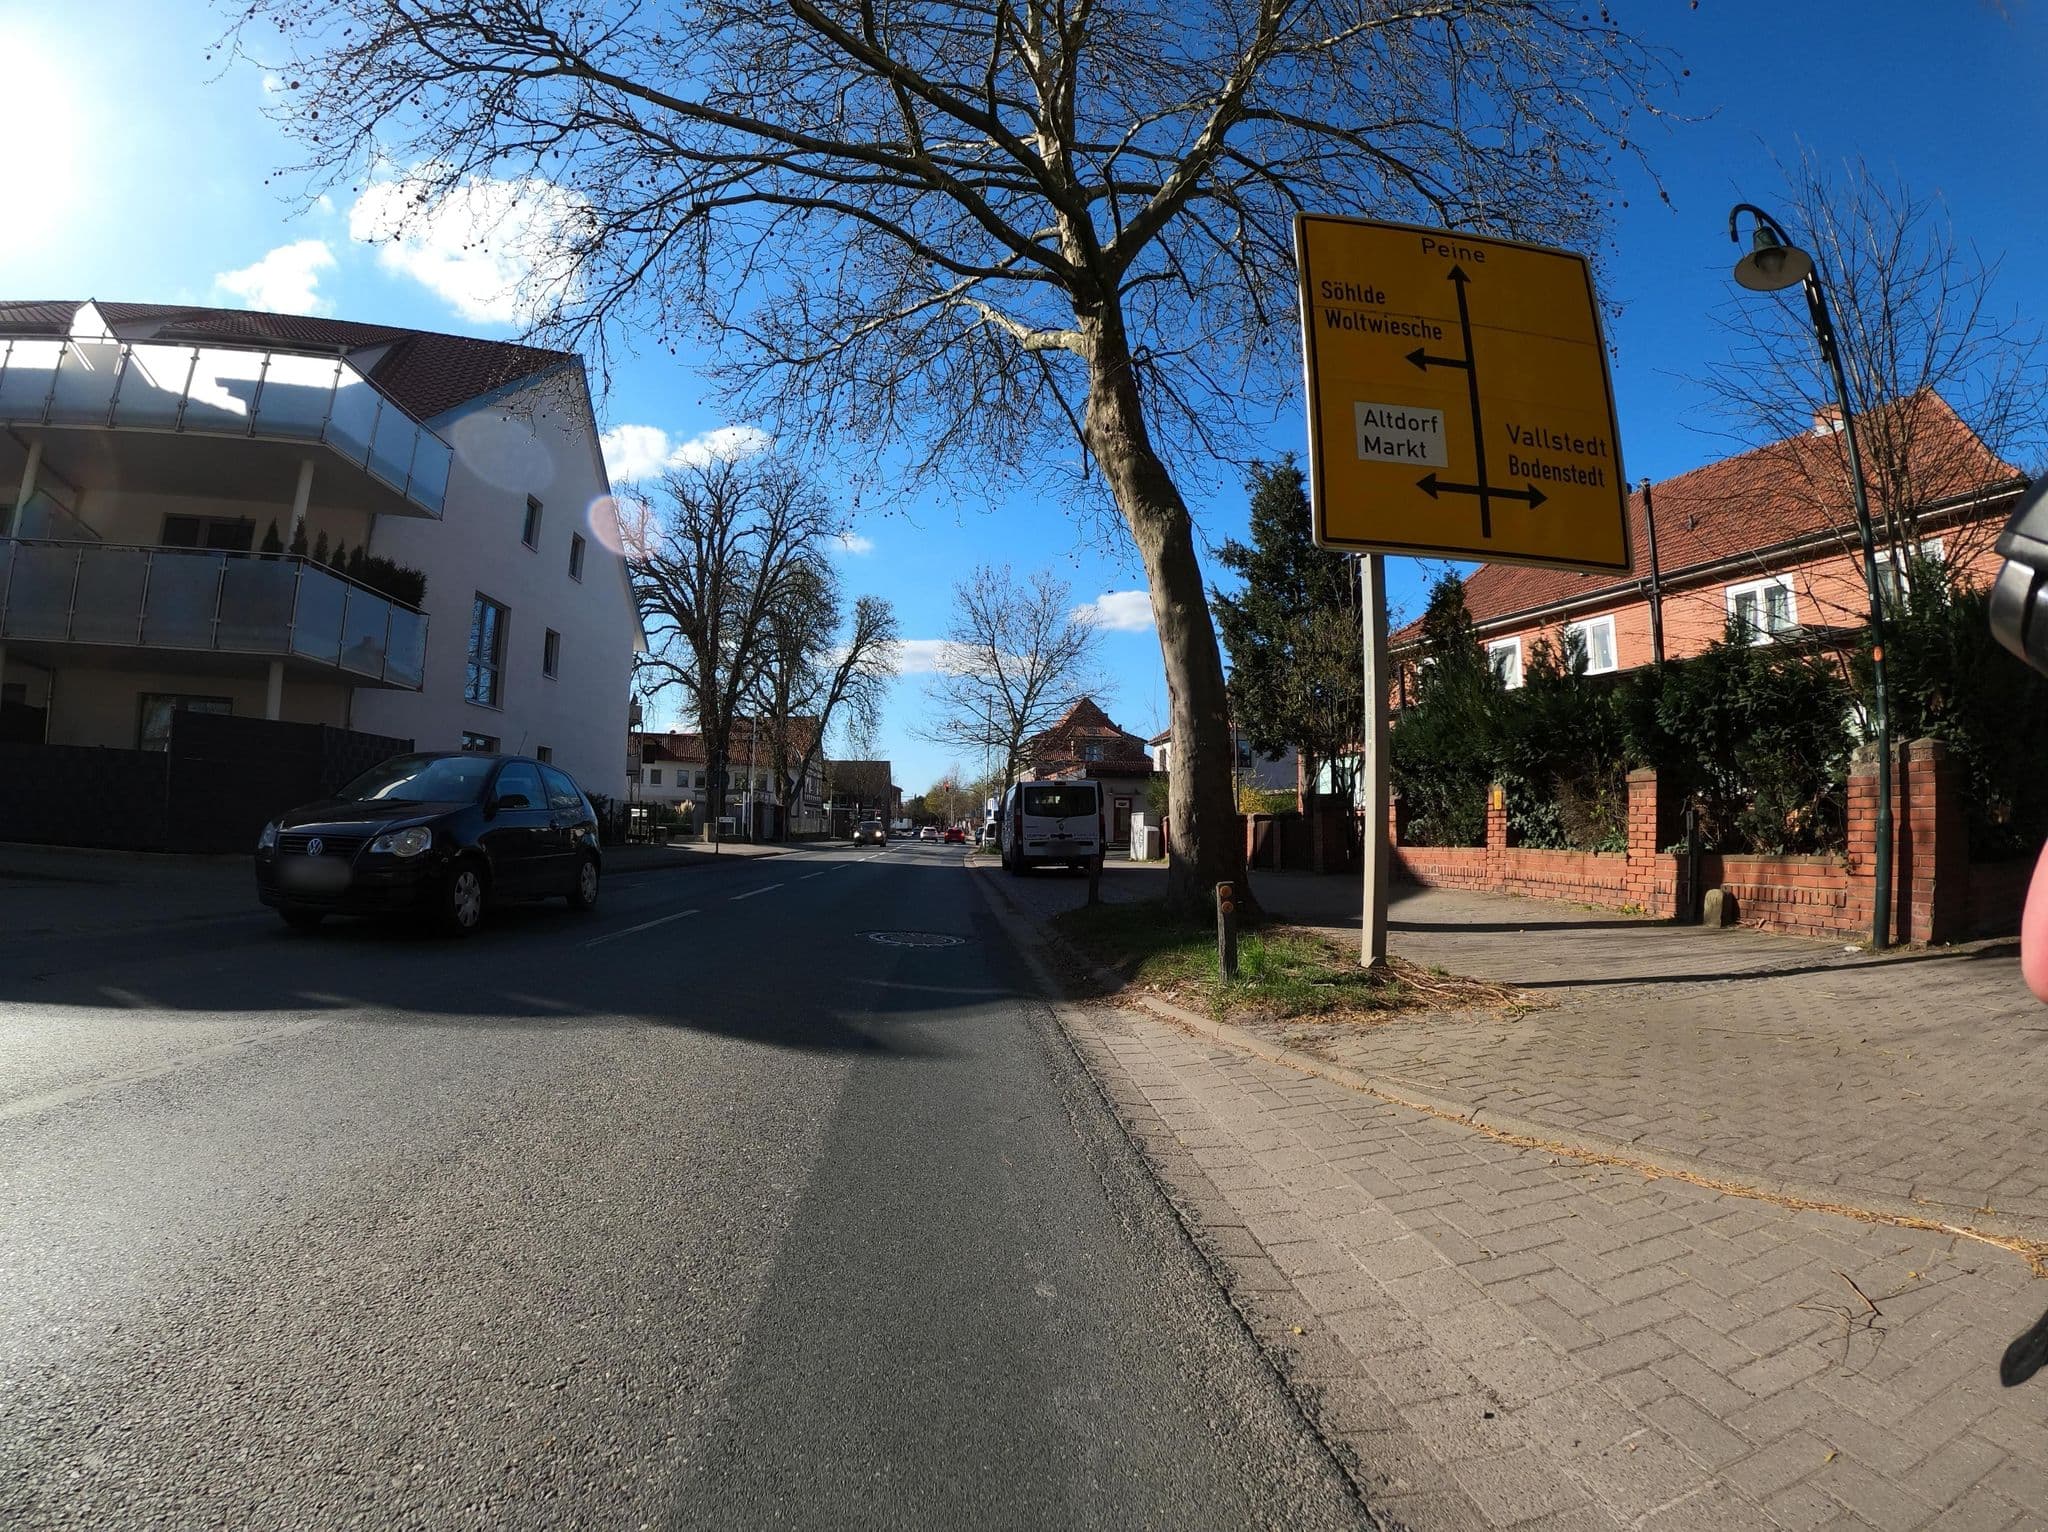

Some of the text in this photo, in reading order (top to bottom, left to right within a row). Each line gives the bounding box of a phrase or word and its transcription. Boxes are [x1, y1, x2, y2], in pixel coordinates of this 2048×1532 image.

[1422, 237, 1486, 263] Peine
[1321, 280, 1386, 305] Söhlde
[1325, 309, 1443, 340] Woltwiesche
[1364, 409, 1438, 434] Altdorf
[1364, 435, 1427, 459] Markt
[1506, 424, 1608, 457] Vallstedt
[1509, 456, 1605, 488] Bodenstedt
